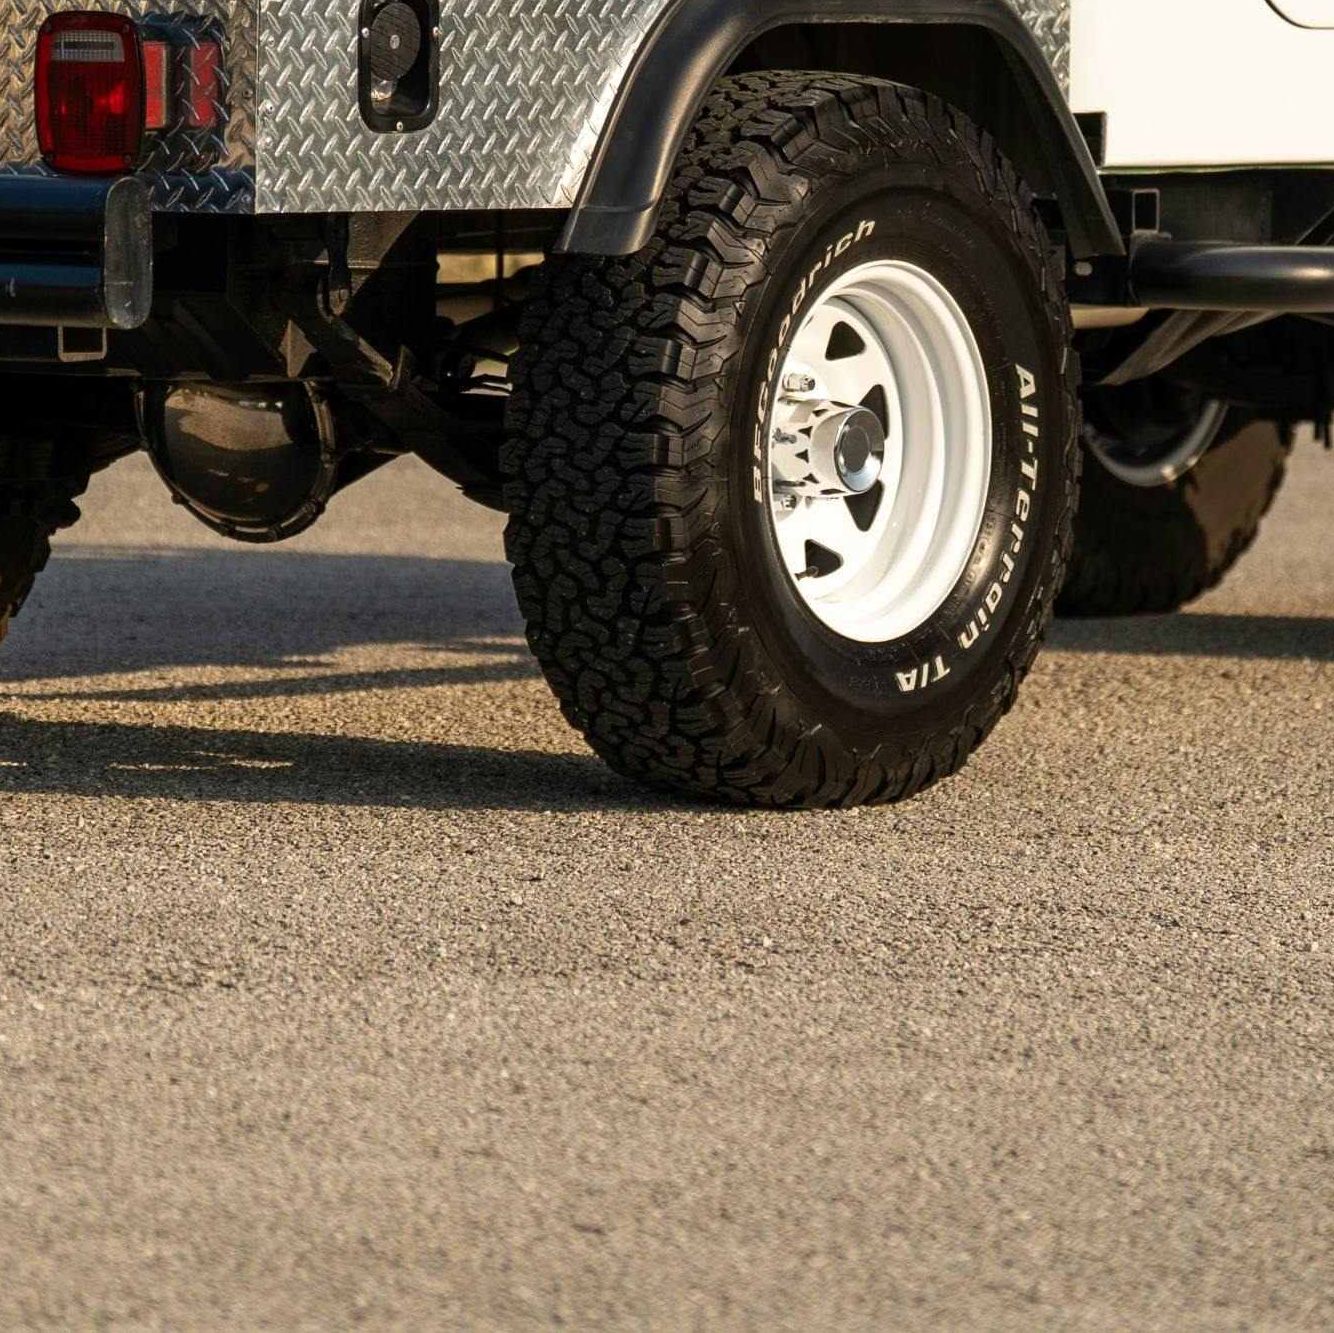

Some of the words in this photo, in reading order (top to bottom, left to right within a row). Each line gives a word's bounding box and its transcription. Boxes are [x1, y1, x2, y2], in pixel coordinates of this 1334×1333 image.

[753, 218, 876, 503] BFGoodrich
[957, 363, 1043, 650] All-Terrain
[895, 654, 952, 693] T/A
